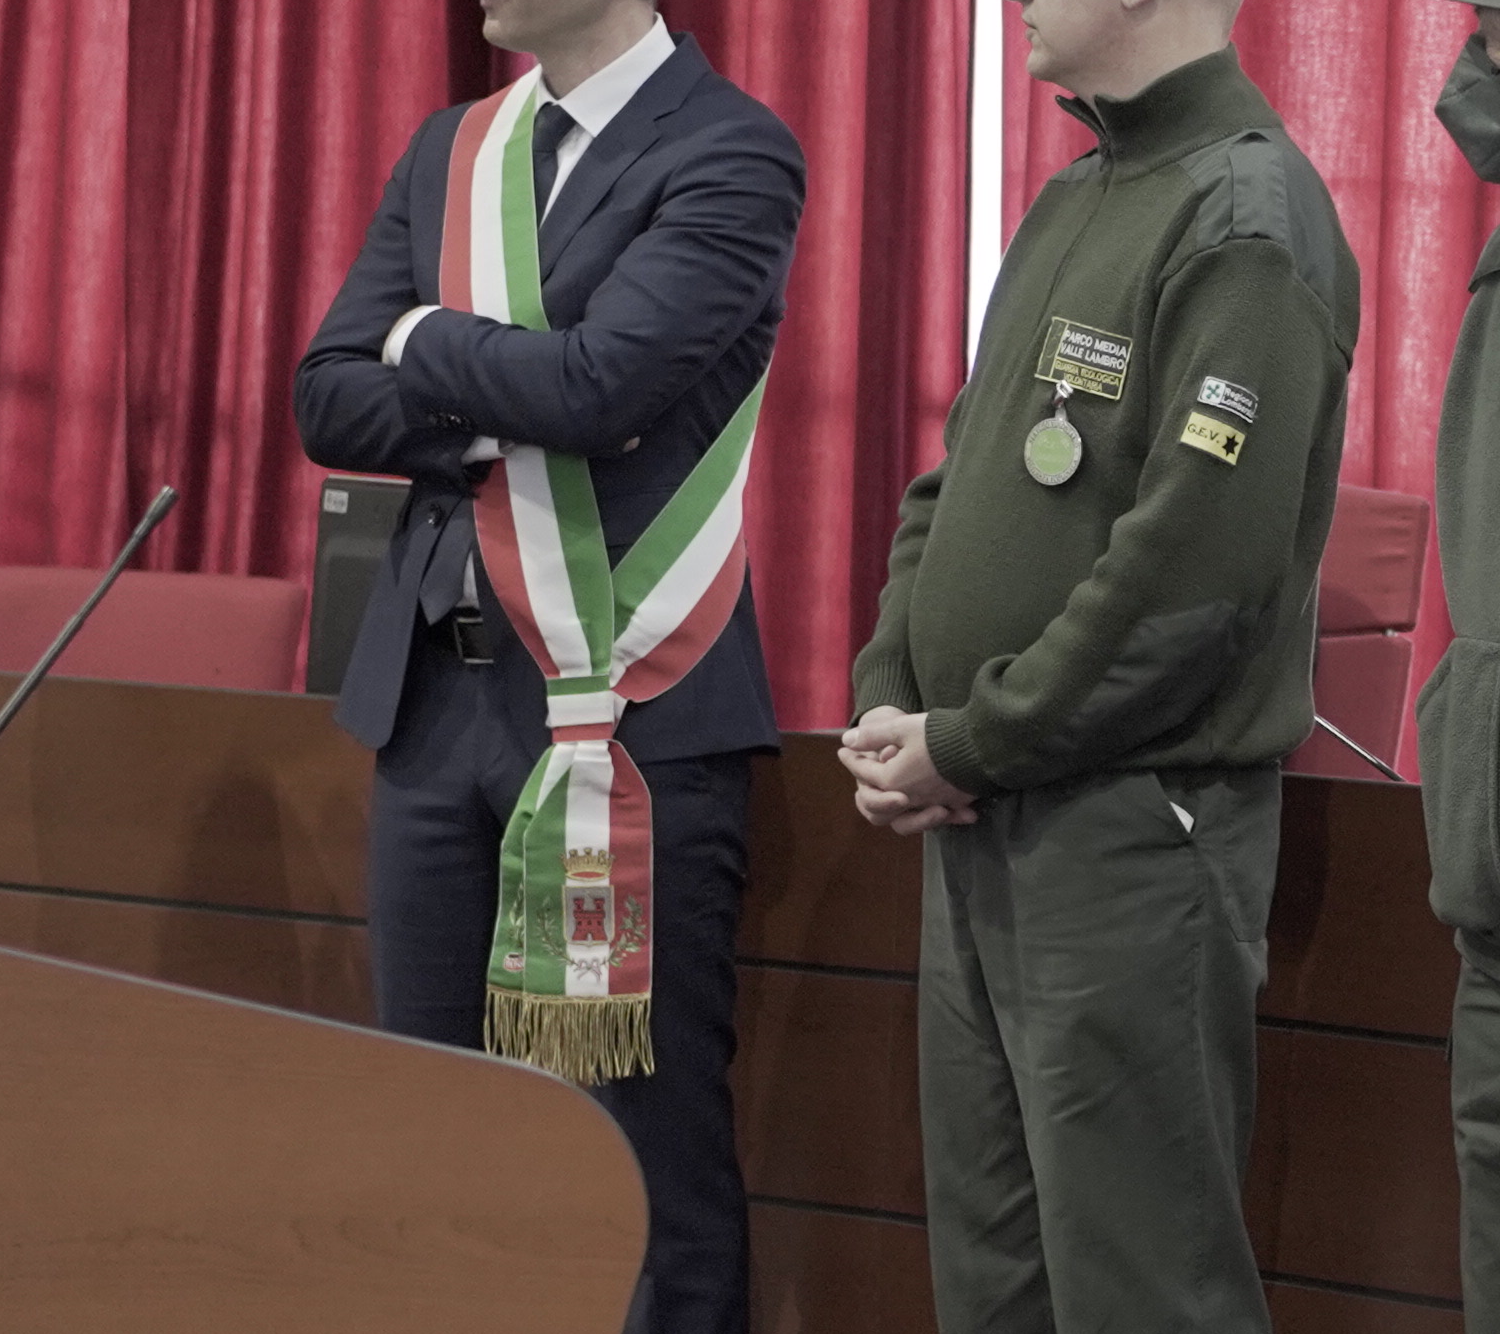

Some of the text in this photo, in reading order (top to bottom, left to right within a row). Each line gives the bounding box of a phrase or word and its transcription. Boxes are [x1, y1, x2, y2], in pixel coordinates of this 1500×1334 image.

[1062, 330, 1127, 358] PARCO MEDIA
[1060, 343, 1125, 370] VALLE LAMBRO
[1080, 366, 1120, 386] ECOLOGICA
[1187, 423, 1220, 444] G.E.V.
